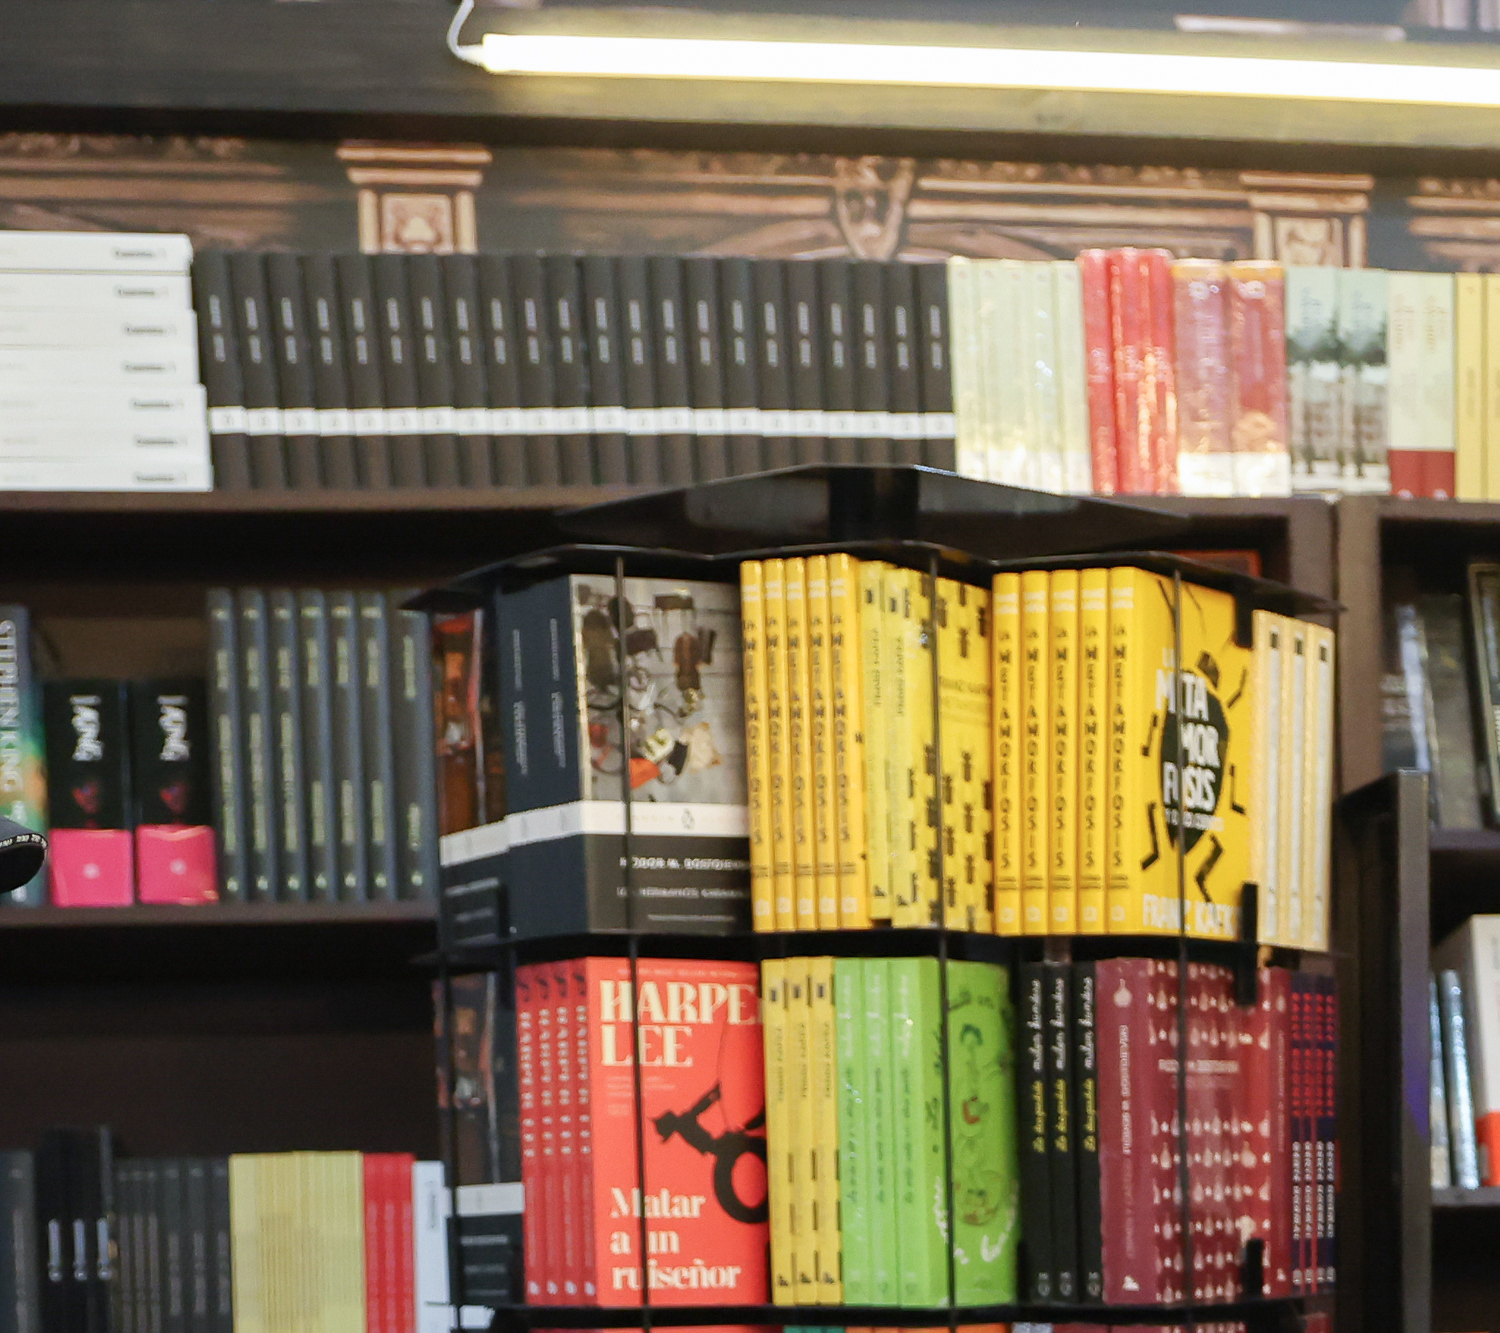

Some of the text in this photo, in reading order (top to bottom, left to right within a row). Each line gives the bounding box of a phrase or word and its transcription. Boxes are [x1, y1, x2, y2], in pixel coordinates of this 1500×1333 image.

[600, 980, 763, 1025] HARPE
[601, 1024, 693, 1067] LEE
[610, 1187, 705, 1218] Matar
